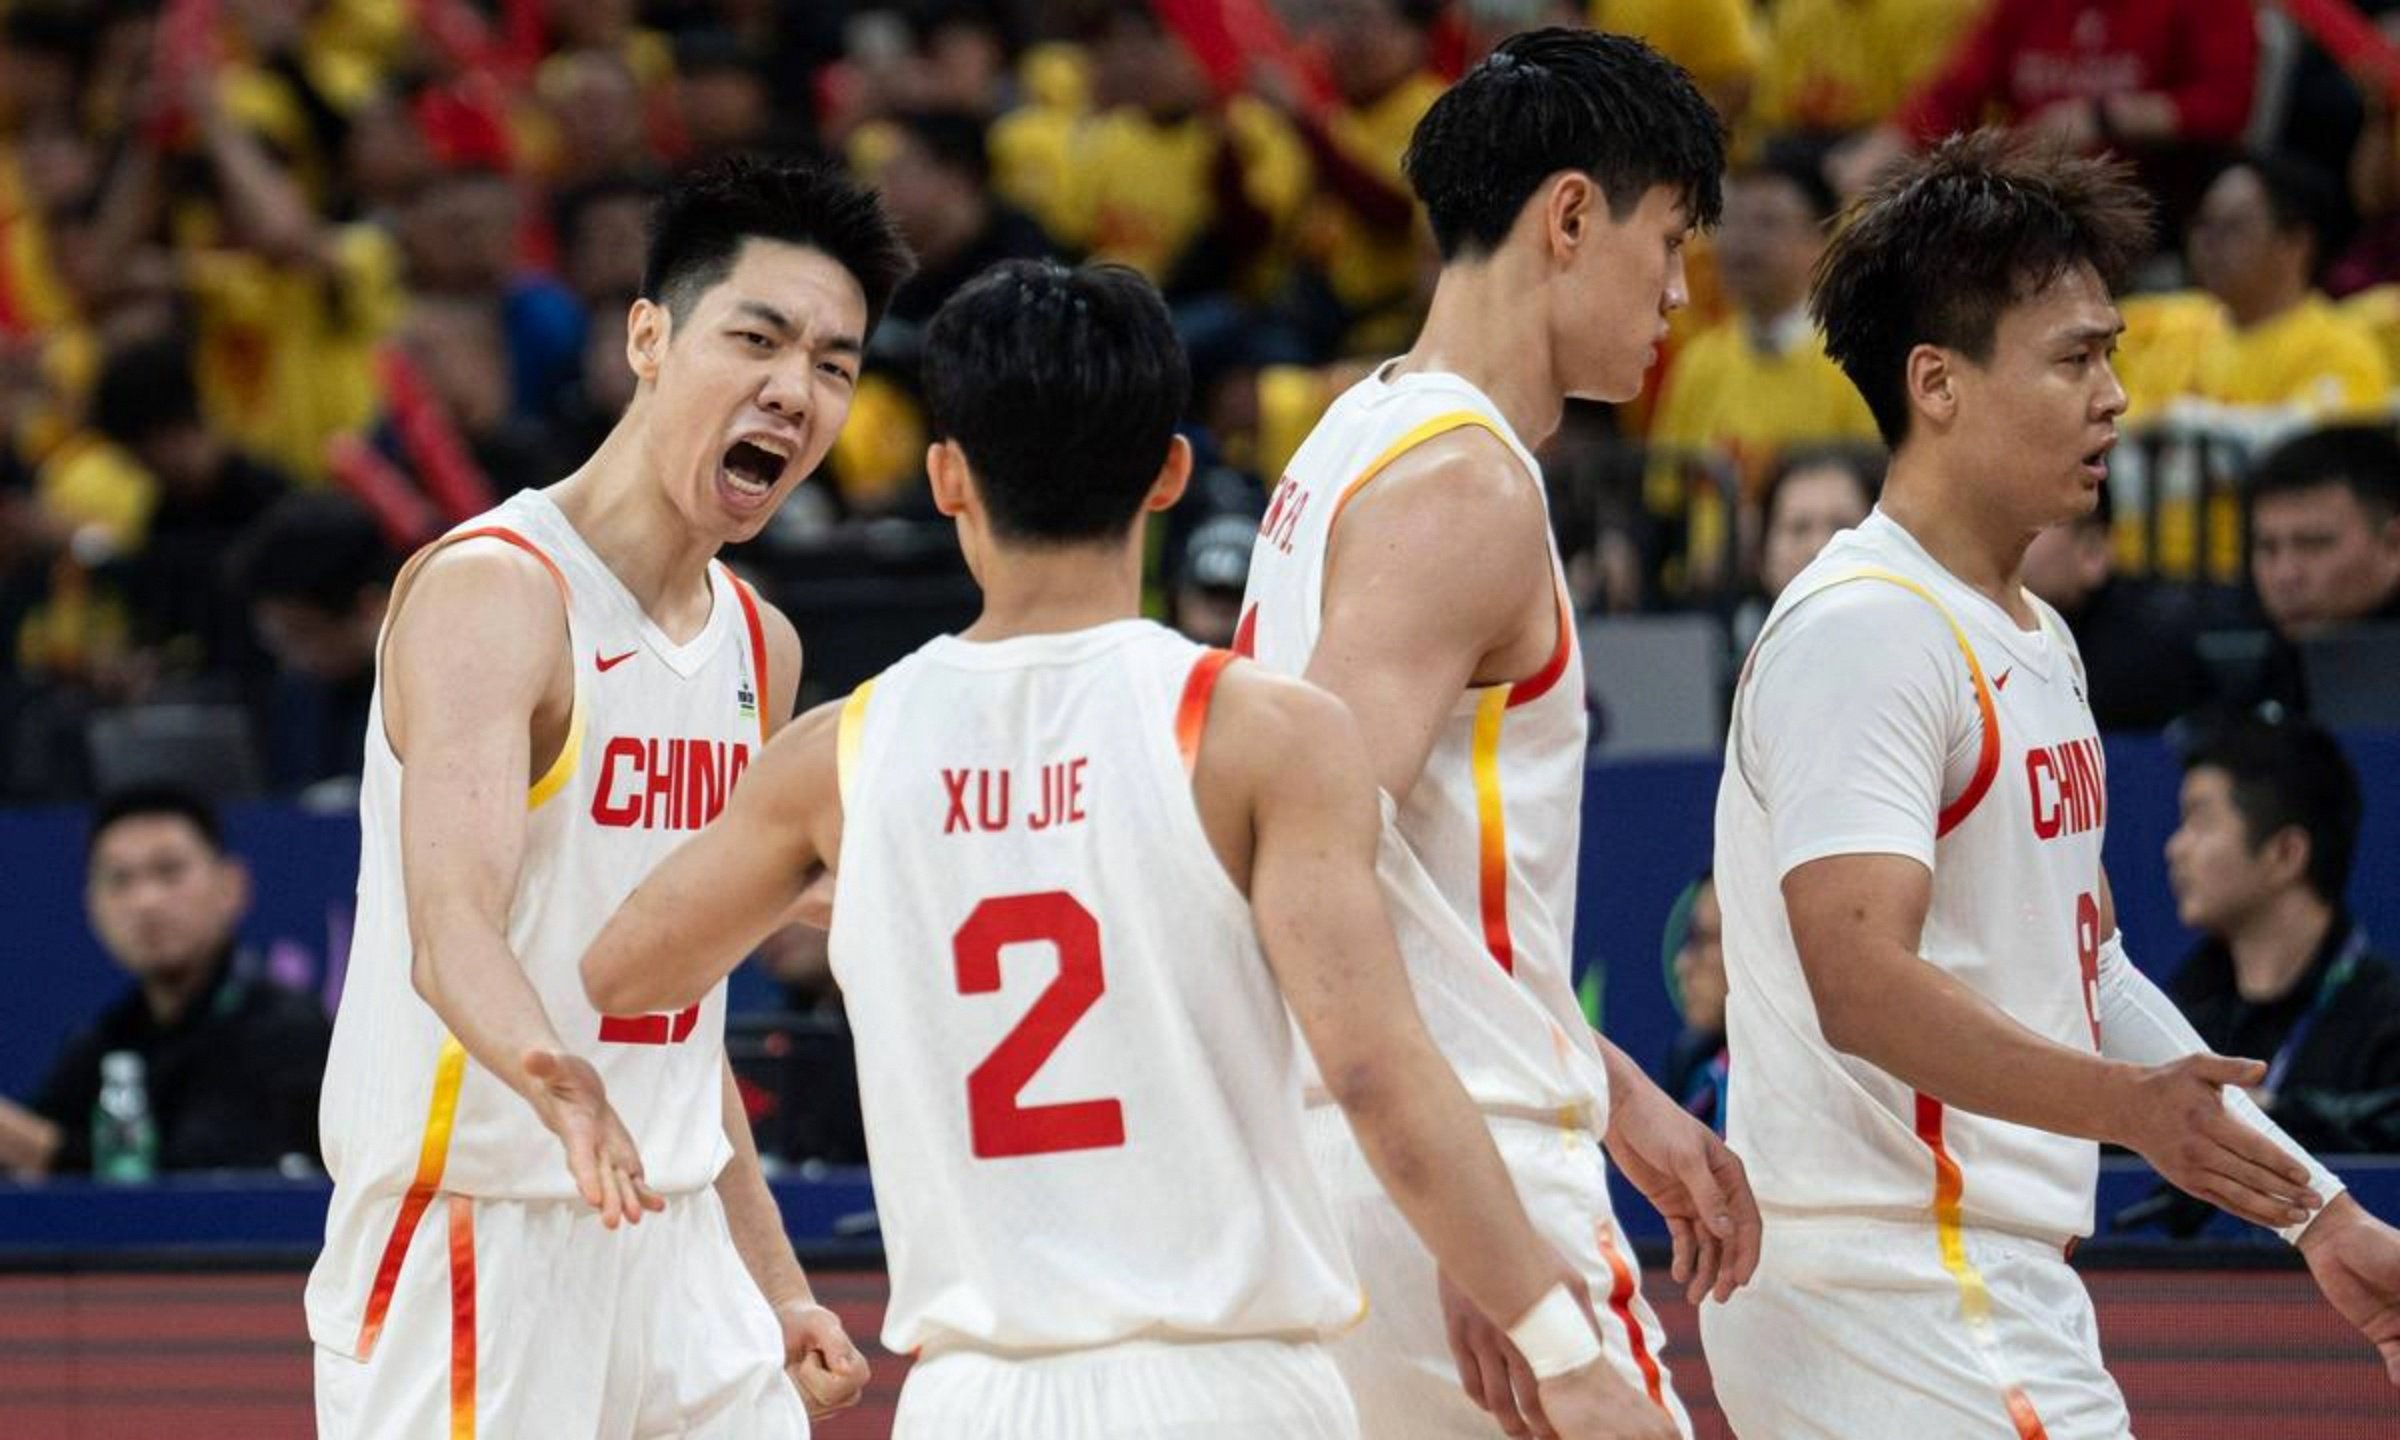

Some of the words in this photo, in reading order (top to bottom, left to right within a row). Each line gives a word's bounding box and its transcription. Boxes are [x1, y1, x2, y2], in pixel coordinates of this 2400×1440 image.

[941, 768, 1011, 834] XU
[1027, 757, 1088, 831] JIE
[952, 890, 1126, 1160] 2
